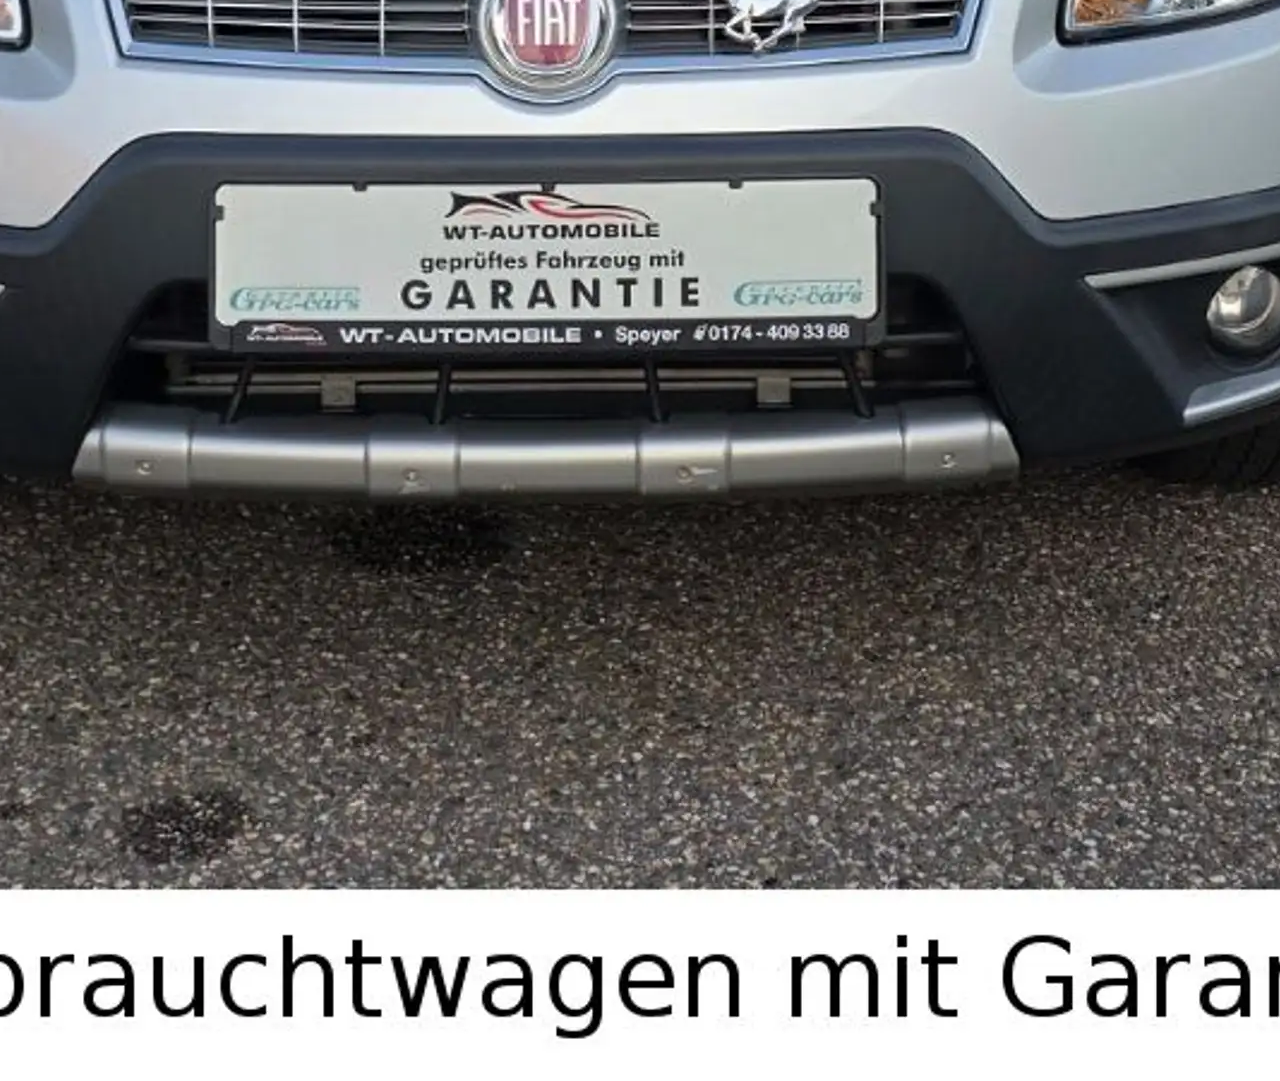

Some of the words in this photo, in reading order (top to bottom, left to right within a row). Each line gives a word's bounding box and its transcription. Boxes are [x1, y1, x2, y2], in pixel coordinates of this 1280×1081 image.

[443, 223, 661, 240] WT-AUTOMOBILE
[420, 250, 528, 273] geprüftes
[536, 250, 641, 271] Fahrzeug
[649, 250, 685, 268] mit
[401, 277, 699, 310] GARANTIE
[339, 327, 582, 344] WT-AUTOMOBILE
[616, 325, 682, 346] Speyer
